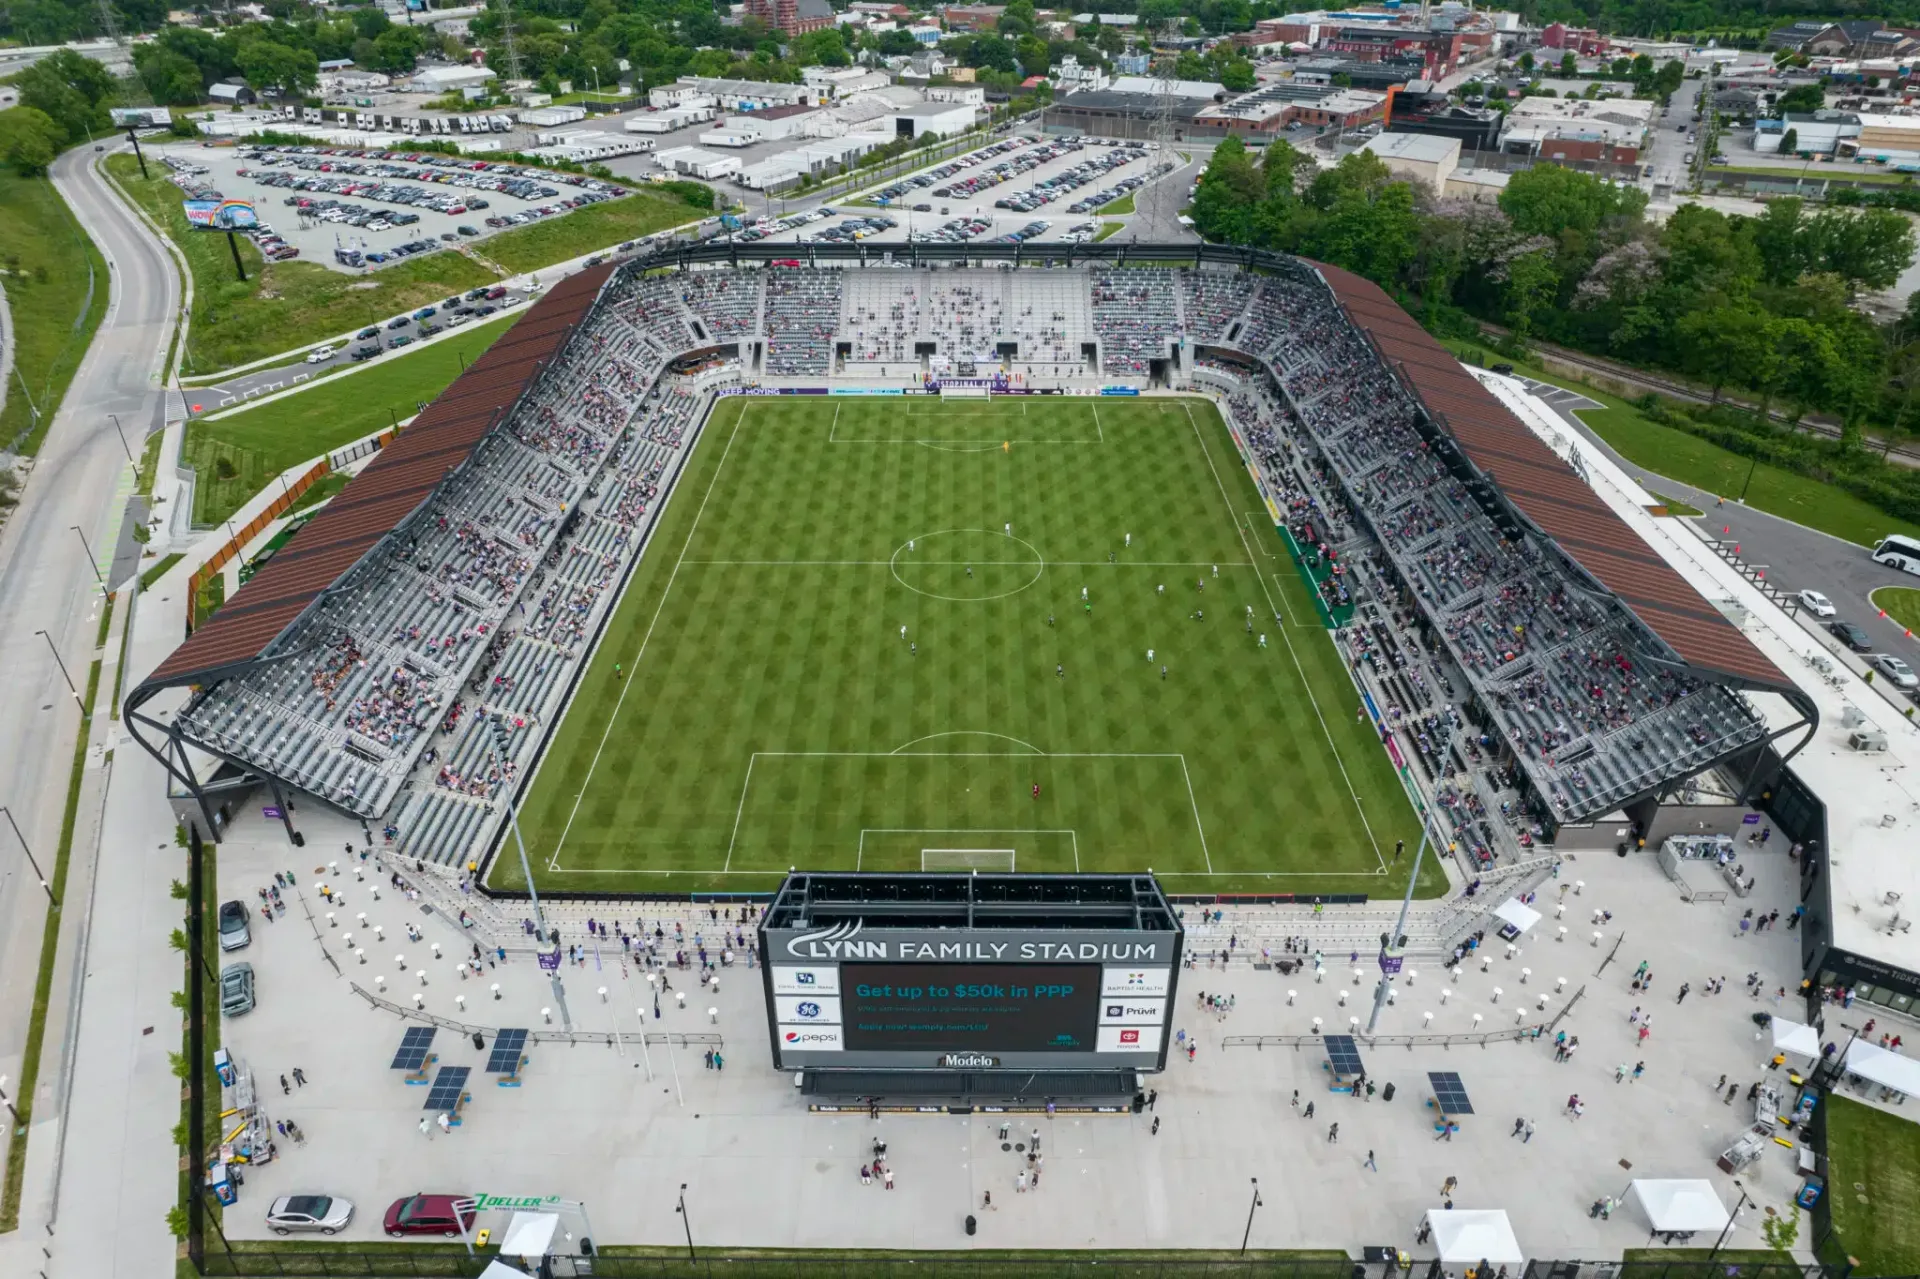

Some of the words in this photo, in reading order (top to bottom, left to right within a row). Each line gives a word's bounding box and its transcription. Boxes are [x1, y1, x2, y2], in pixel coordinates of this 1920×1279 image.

[719, 388, 743, 397] KEEP
[745, 388, 780, 396] MOVING
[809, 940, 887, 958] LYNN
[900, 942, 1008, 959] FAMILY
[1020, 942, 1156, 960] STADIUM
[856, 984, 891, 998] Get
[897, 986, 922, 1000] up
[928, 985, 950, 998] to
[954, 983, 1004, 999] $50k
[1010, 984, 1029, 998] in
[1034, 984, 1074, 998] PPP
[802, 1034, 837, 1043] pepsi
[945, 1054, 993, 1067] Modelo
[475, 1193, 542, 1211] ZOELLER
